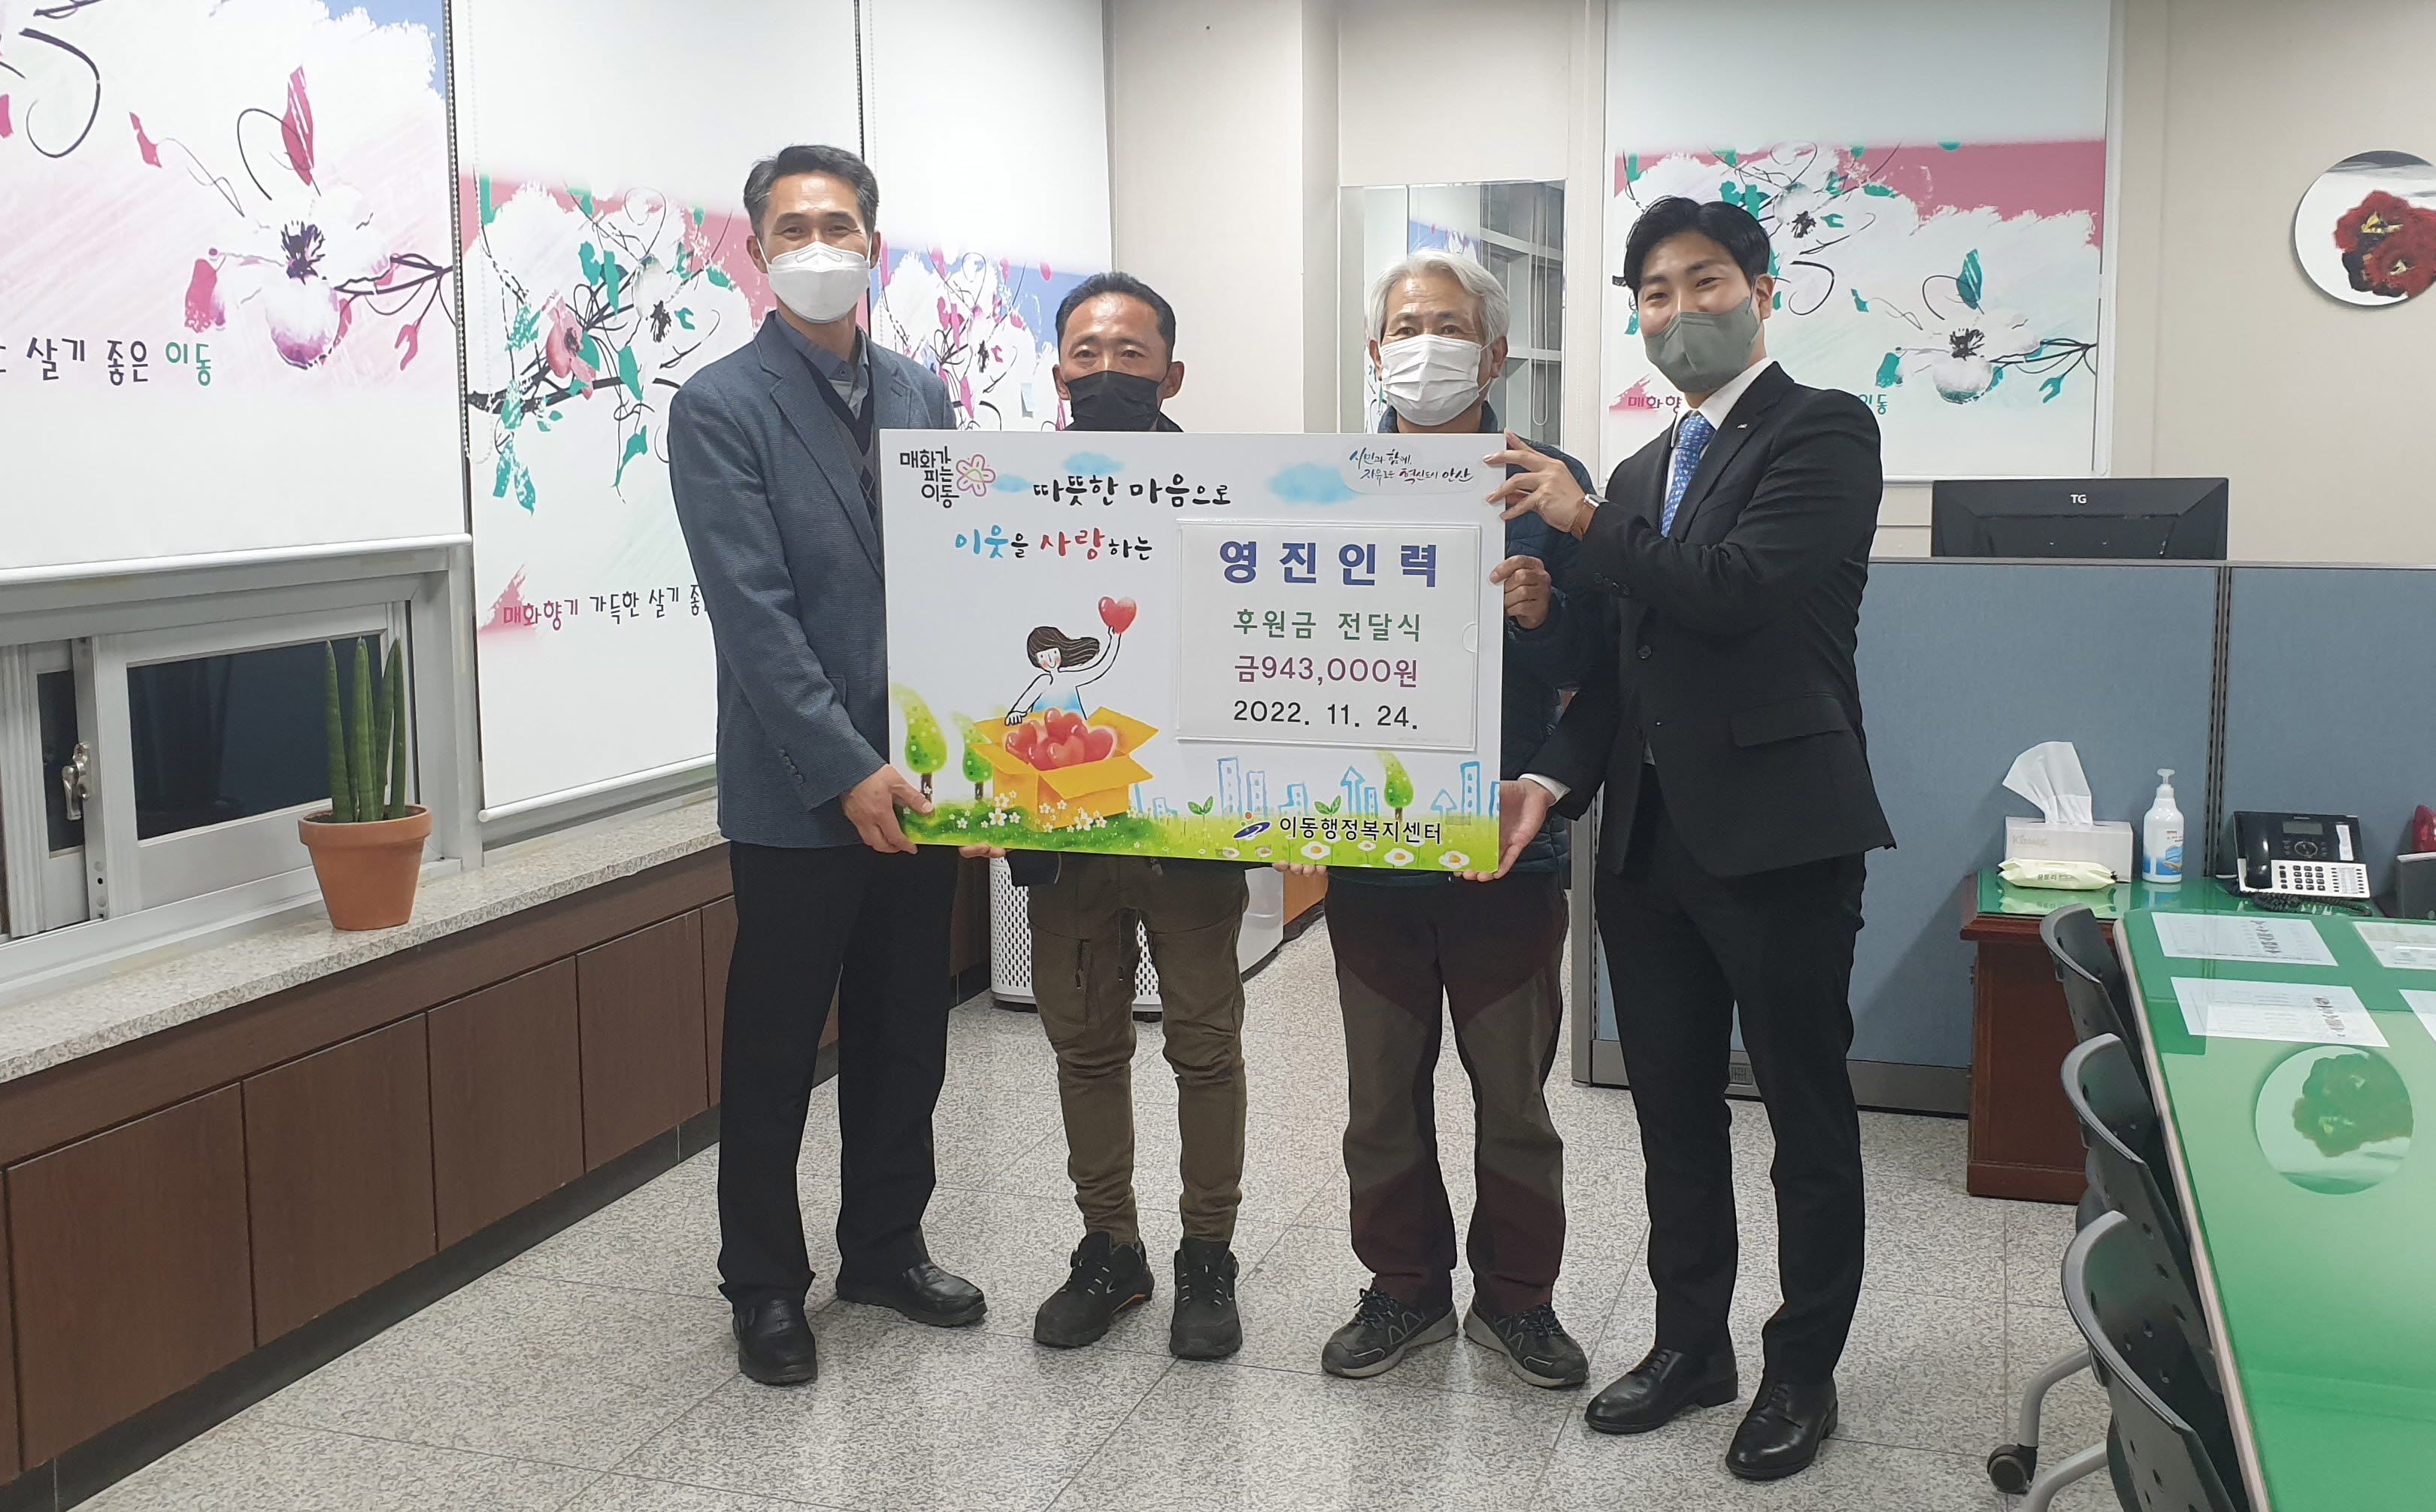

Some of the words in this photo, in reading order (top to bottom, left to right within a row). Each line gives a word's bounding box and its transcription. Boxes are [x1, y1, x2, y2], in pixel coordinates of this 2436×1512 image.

[26, 337, 85, 380] 살기
[108, 340, 148, 386] 좋은
[165, 341, 211, 386] 이동
[1628, 395, 1683, 414] 매화향
[900, 446, 951, 468] 매화가
[924, 466, 953, 483] 피는
[1441, 467, 1474, 482] 안산
[921, 482, 959, 508] 이동
[1034, 474, 1119, 507] 따뜻한
[1129, 474, 1231, 508] 마음으로
[2070, 494, 2087, 505] TG
[955, 524, 1029, 559] 이웃을
[1040, 527, 1153, 561] 사랑하는
[503, 598, 579, 632] 매화향기
[589, 590, 640, 625] 가득한
[648, 586, 680, 619] 살기
[689, 584, 707, 617] 좋
[1233, 608, 1316, 639] 후원금
[1338, 611, 1420, 643] 전달식
[1234, 655, 1418, 689] 금943,000원
[1233, 700, 1310, 726] 2022.
[1327, 703, 1360, 728] 11.
[1377, 704, 1418, 730] 24.
[1280, 816, 1443, 844] 이동행정복지센터
